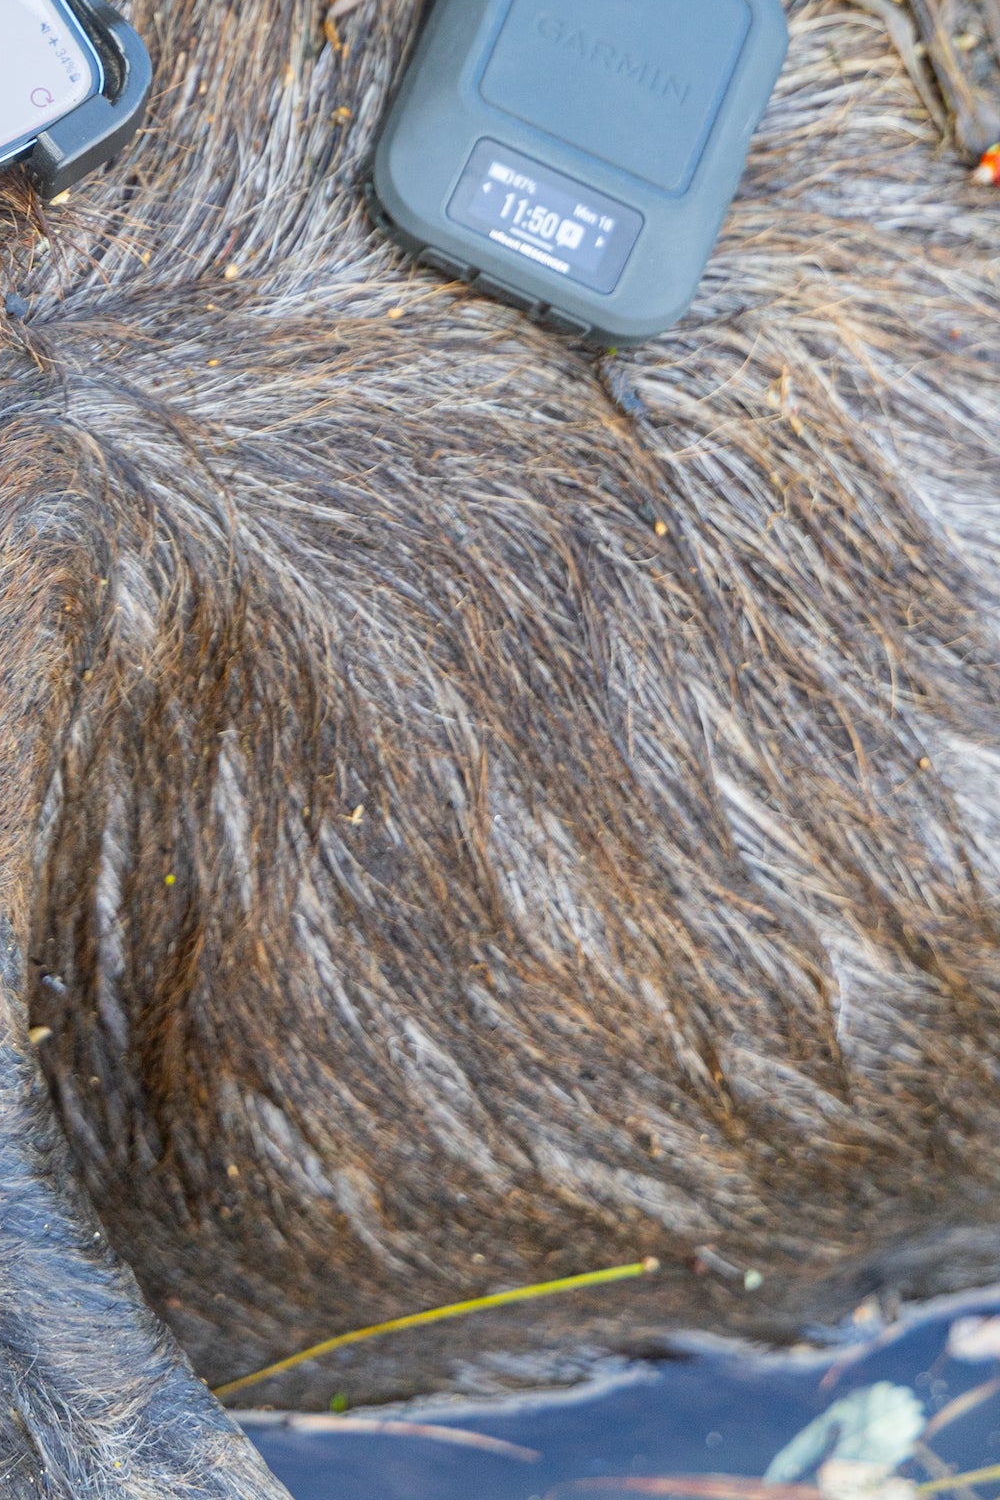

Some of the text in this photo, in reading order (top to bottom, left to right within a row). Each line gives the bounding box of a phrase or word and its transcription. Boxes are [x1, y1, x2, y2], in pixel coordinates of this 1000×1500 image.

[54, 47, 75, 74] 34%
[536, 15, 690, 105] GARMIN
[500, 193, 557, 238] 11:50
